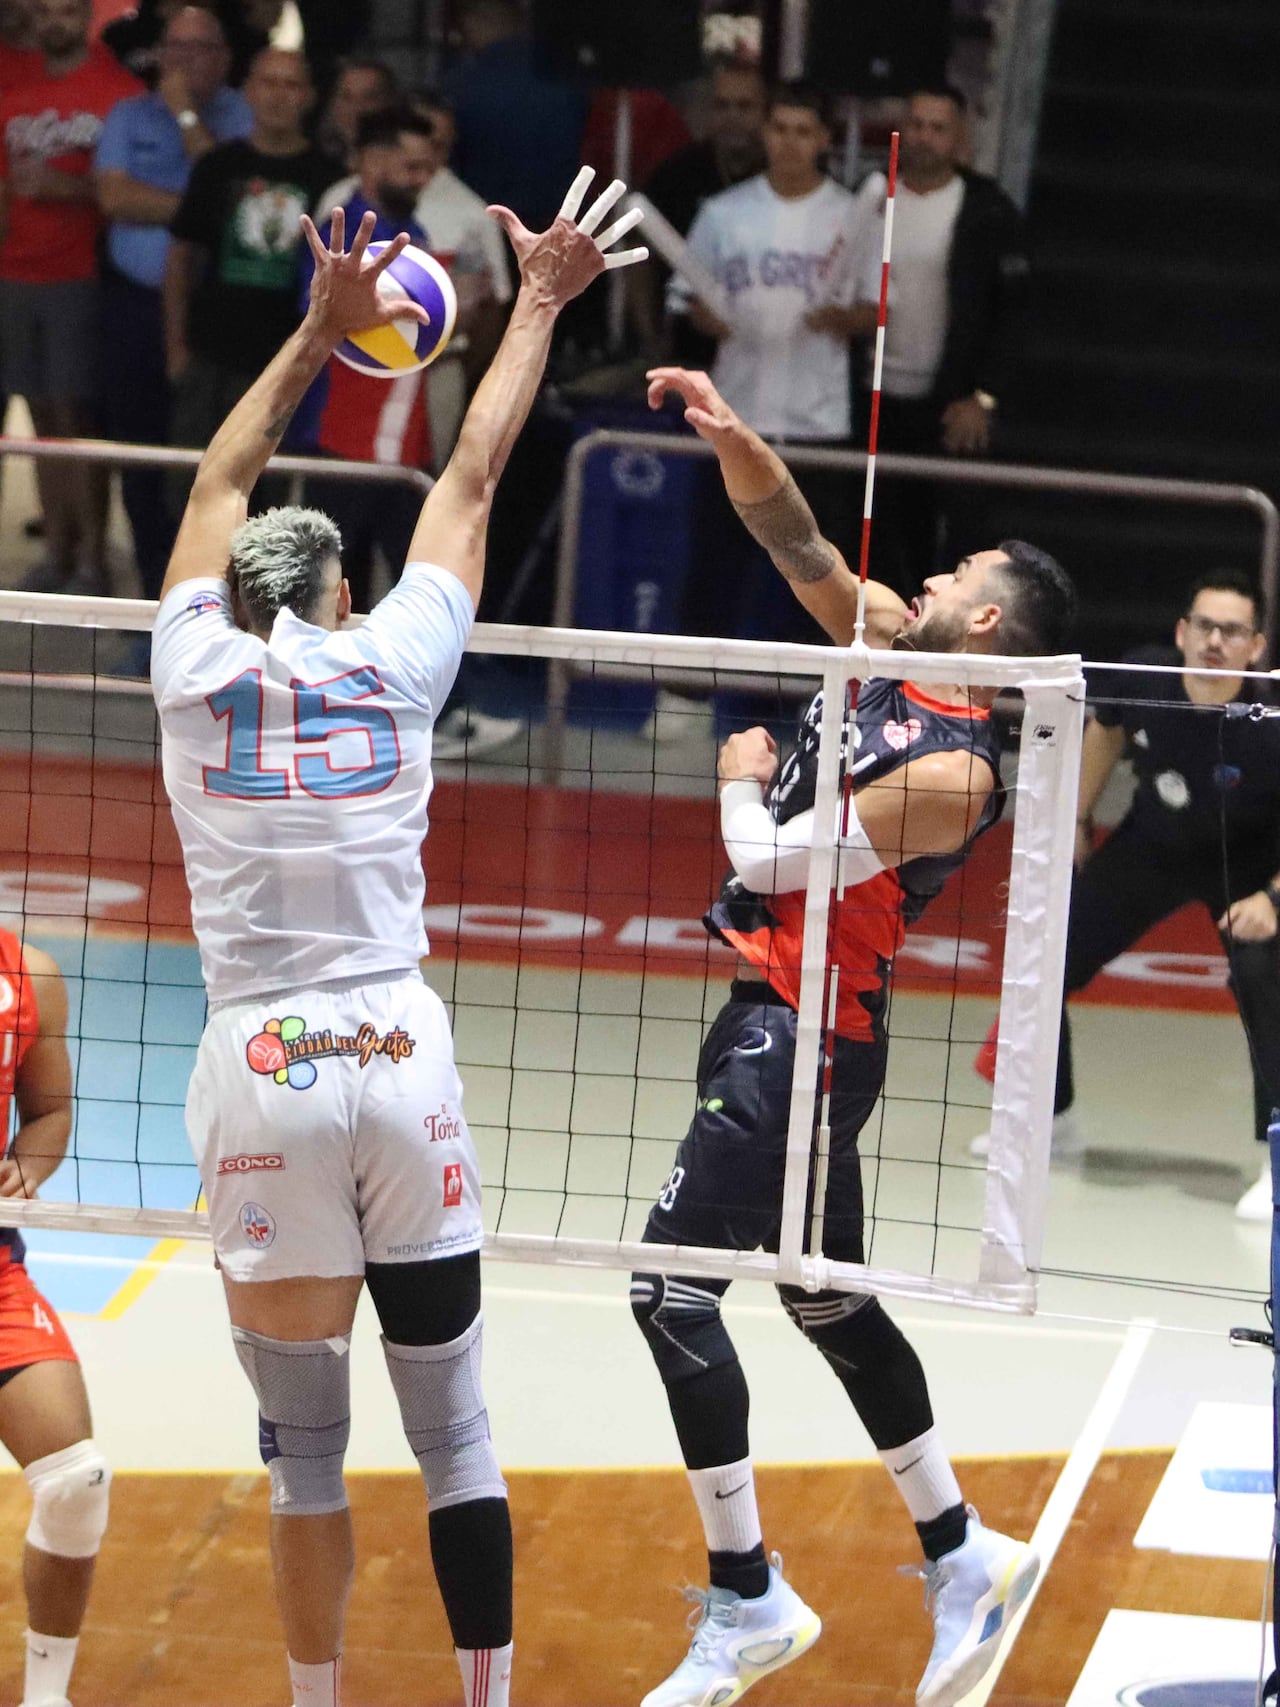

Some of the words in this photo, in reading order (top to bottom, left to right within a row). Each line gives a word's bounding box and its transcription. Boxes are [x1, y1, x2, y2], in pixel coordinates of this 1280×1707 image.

[202, 666, 402, 799] 15
[217, 1157, 281, 1173] ECONO
[659, 1166, 686, 1212] 8
[32, 1302, 55, 1336] 4
